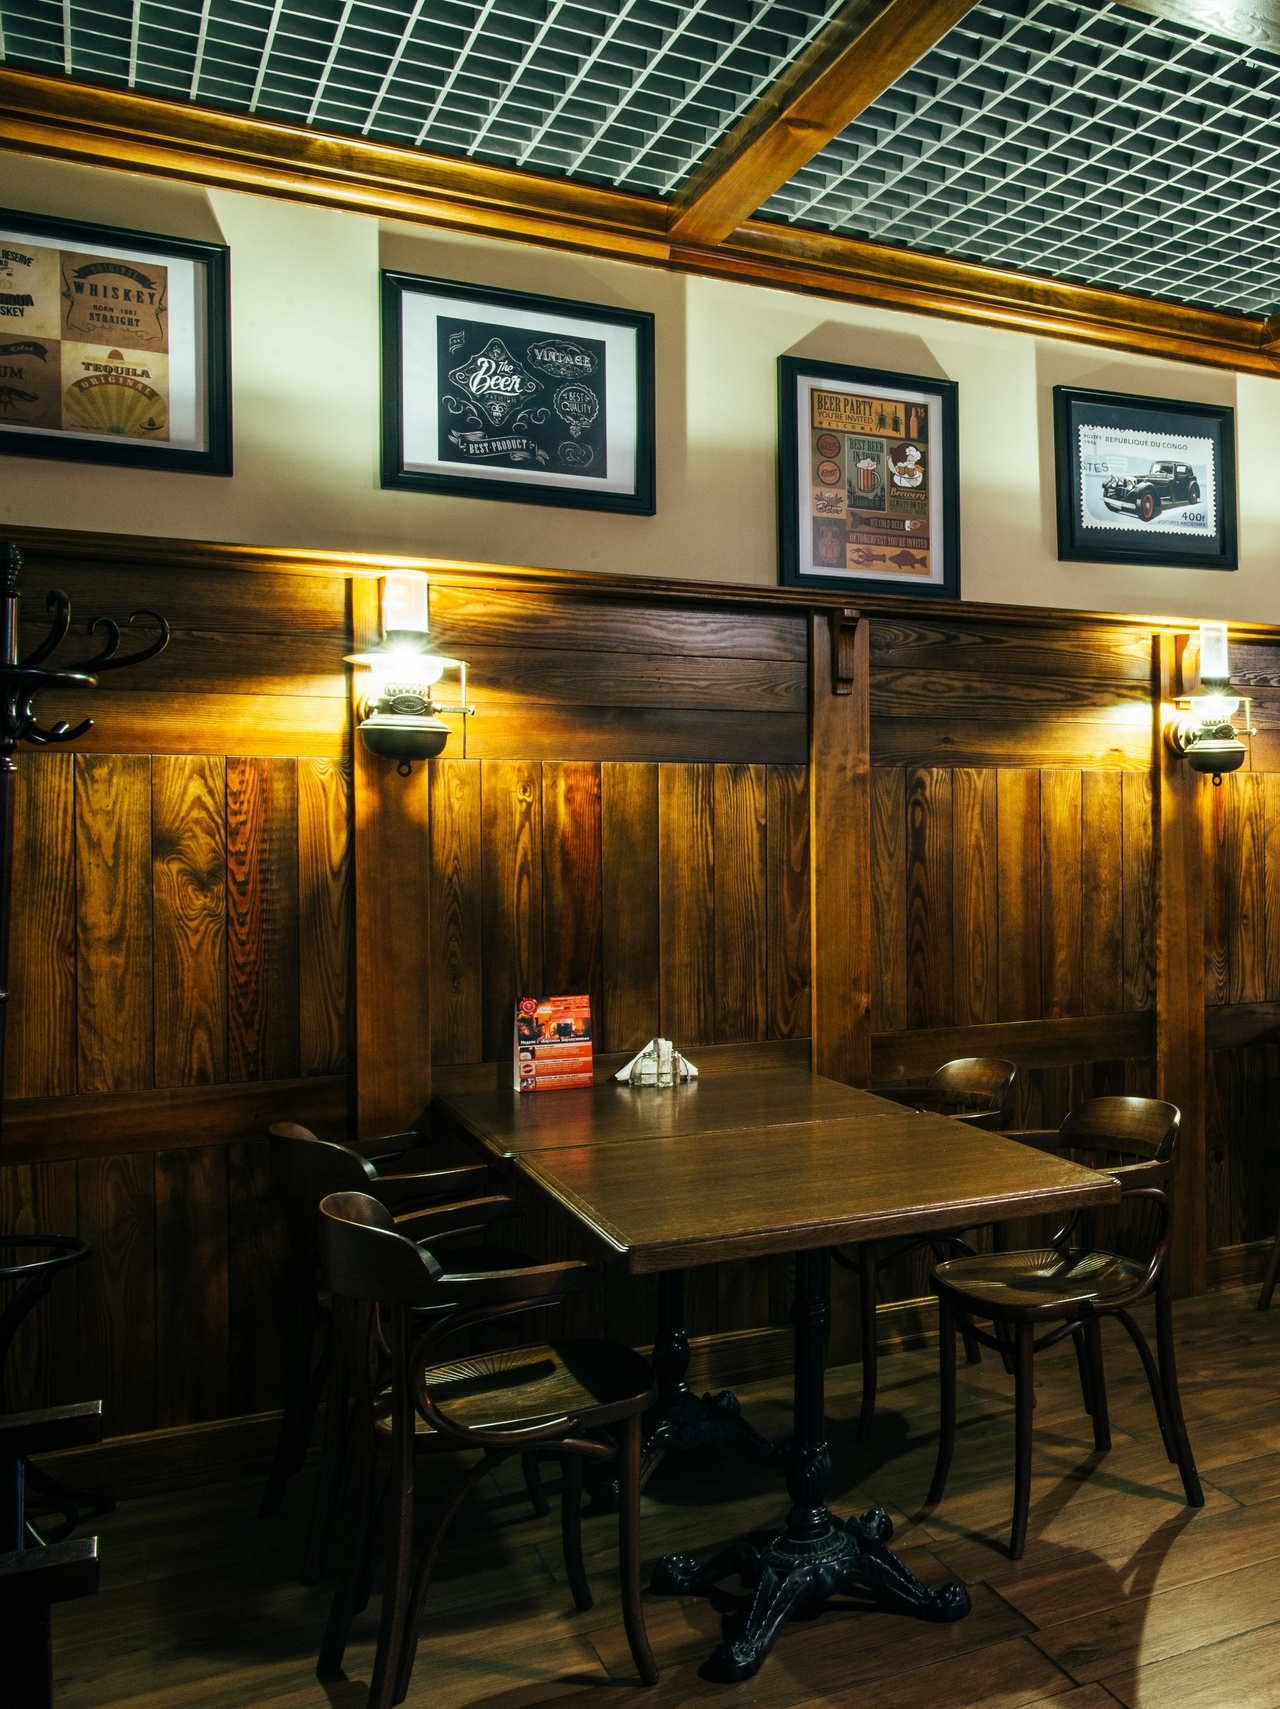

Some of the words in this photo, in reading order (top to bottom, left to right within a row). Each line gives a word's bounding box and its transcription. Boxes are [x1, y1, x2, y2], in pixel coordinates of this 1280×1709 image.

[2, 249, 34, 267] RESERVE
[90, 264, 138, 279] ORIGINAL
[72, 281, 156, 305] WHISKEY
[93, 304, 114, 312] BORN
[89, 312, 140, 327] STRAIGHT
[533, 348, 591, 367] VINTAGE
[81, 361, 151, 378] TEQUILA
[496, 360, 514, 373] The
[469, 358, 523, 394] Beer
[81, 376, 151, 395] ORIGINAL
[569, 391, 584, 401] BEST
[561, 401, 592, 413] QUALITY
[817, 394, 841, 413] BEER
[843, 398, 873, 416] PARTY
[817, 411, 843, 420] YOU'RE
[846, 414, 873, 424] INVITED
[818, 421, 873, 432] WELCOME
[469, 443, 489, 454] BEST
[491, 439, 528, 452] PRODUCT
[850, 439, 866, 450] BEST
[867, 441, 884, 453] BEER
[1105, 436, 1149, 447] REPUBLIQUE
[1162, 442, 1188, 451] CONGO
[853, 451, 860, 462] IN
[861, 452, 880, 464] TOWN
[890, 487, 926, 500] Brewery
[816, 500, 843, 515] Beer
[892, 519, 903, 529] BEER
[849, 533, 887, 545] OKTOBERFEST
[888, 536, 906, 547] YOU'RE
[907, 538, 928, 549] INVITED
